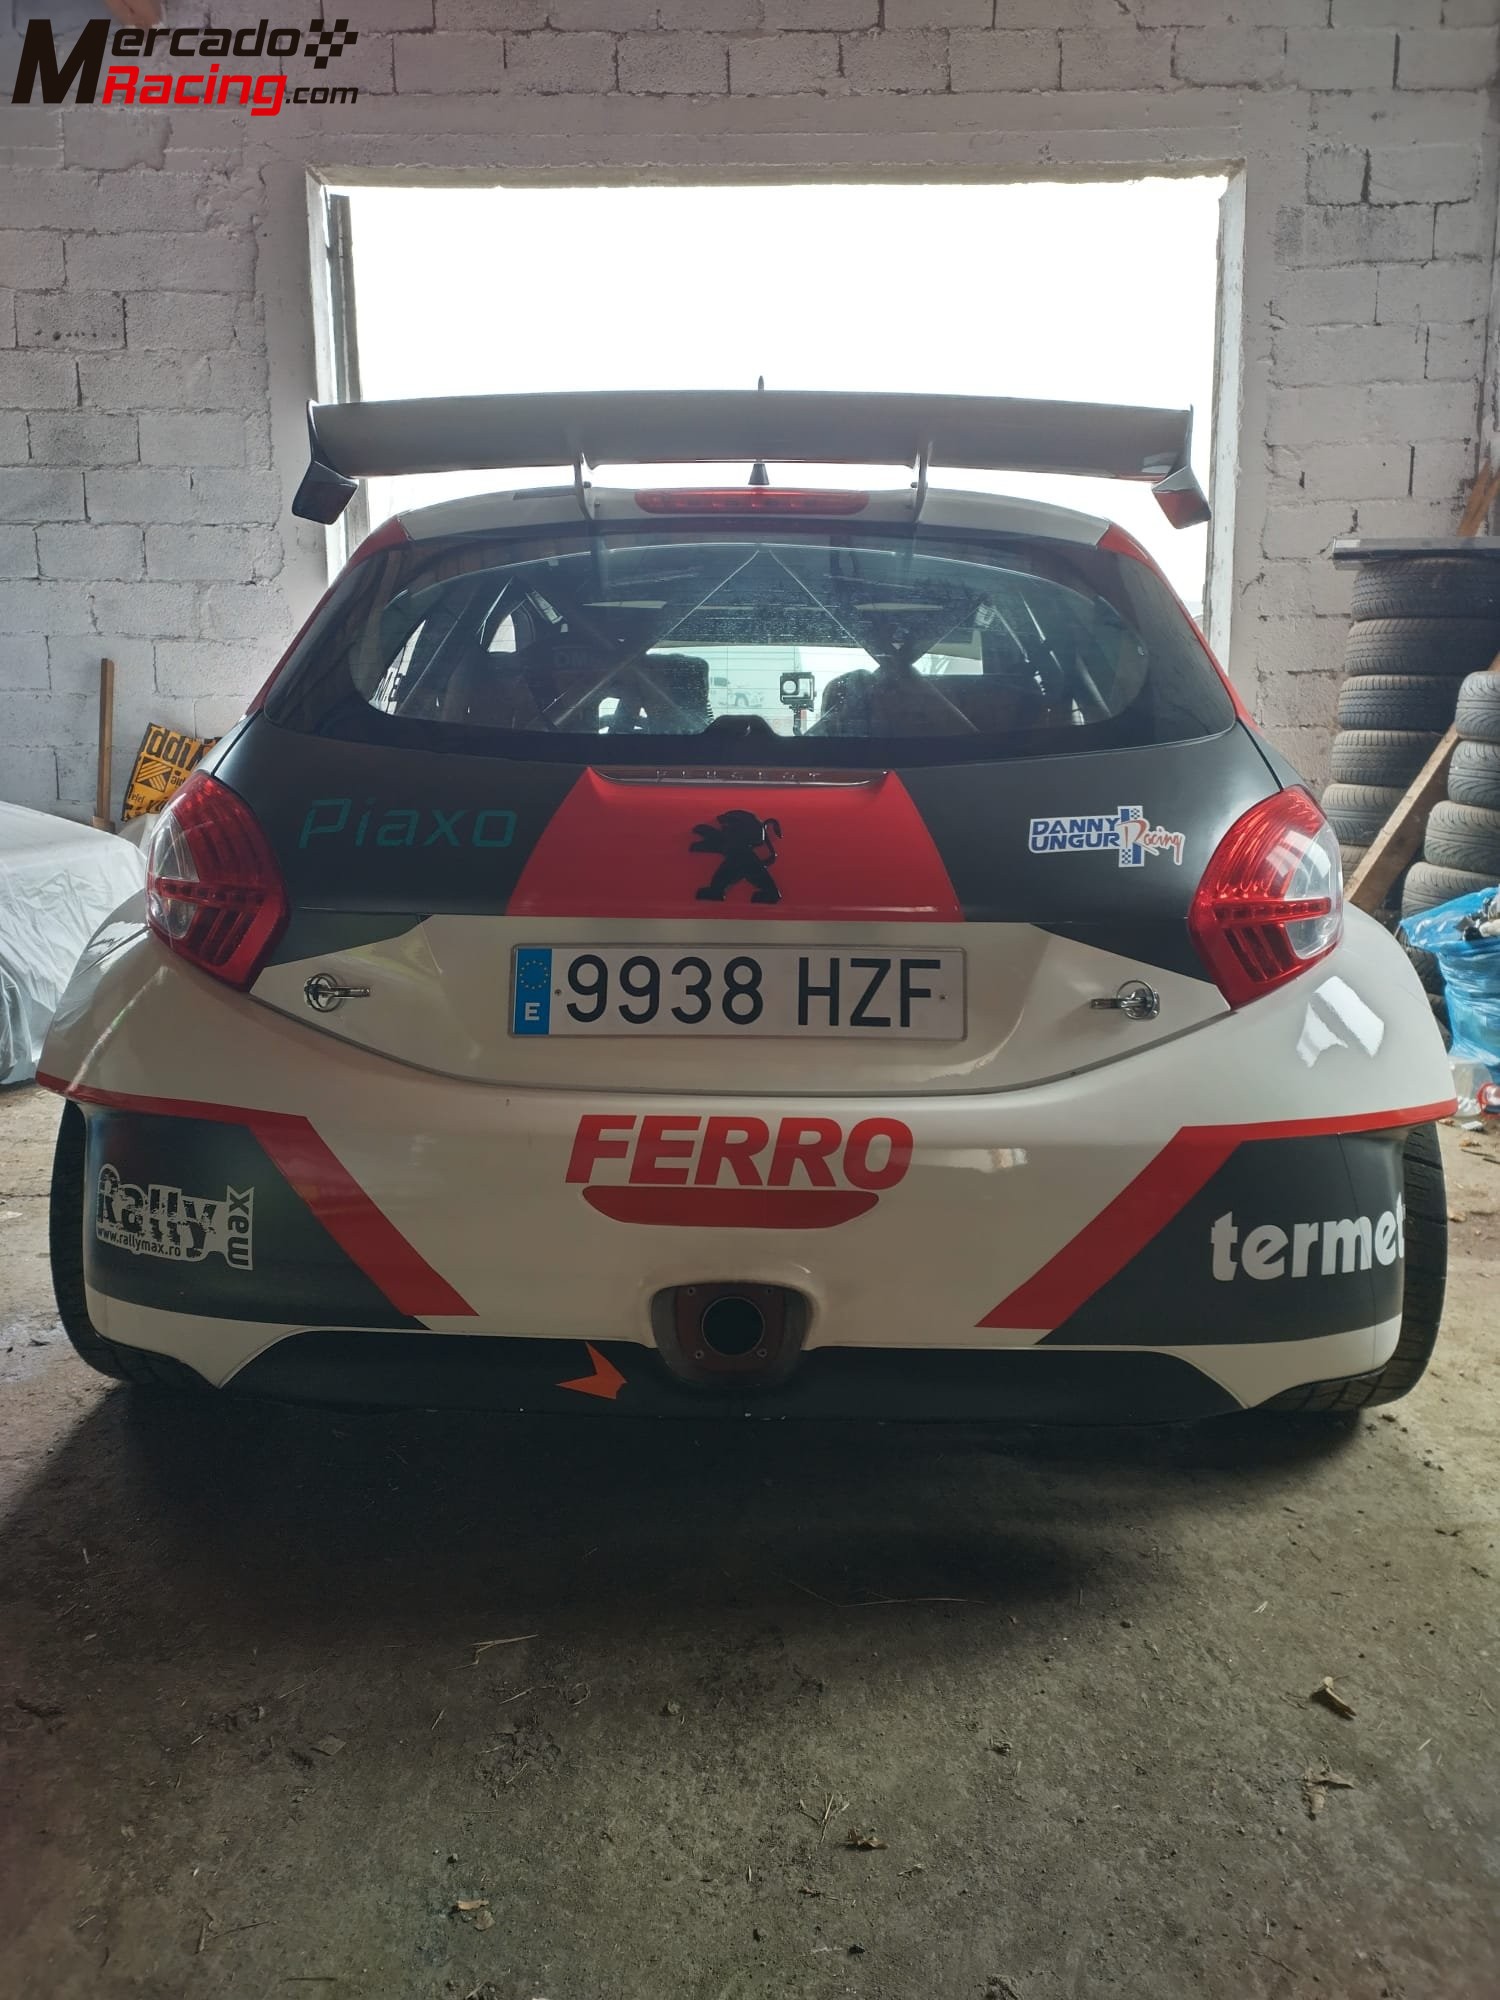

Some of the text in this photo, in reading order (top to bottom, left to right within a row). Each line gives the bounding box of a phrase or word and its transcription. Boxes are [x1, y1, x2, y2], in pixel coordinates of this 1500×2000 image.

[298, 798, 518, 848] Piaxo
[1031, 832, 1120, 851] UNGUR
[1032, 817, 1120, 836] DANNY
[1117, 818, 1183, 863] Racing
[524, 953, 942, 1028] E 9938 HZF
[565, 1114, 914, 1190] FERRO
[97, 1226, 182, 1257] www.rallymax.ro
[226, 1190, 250, 1267] max
